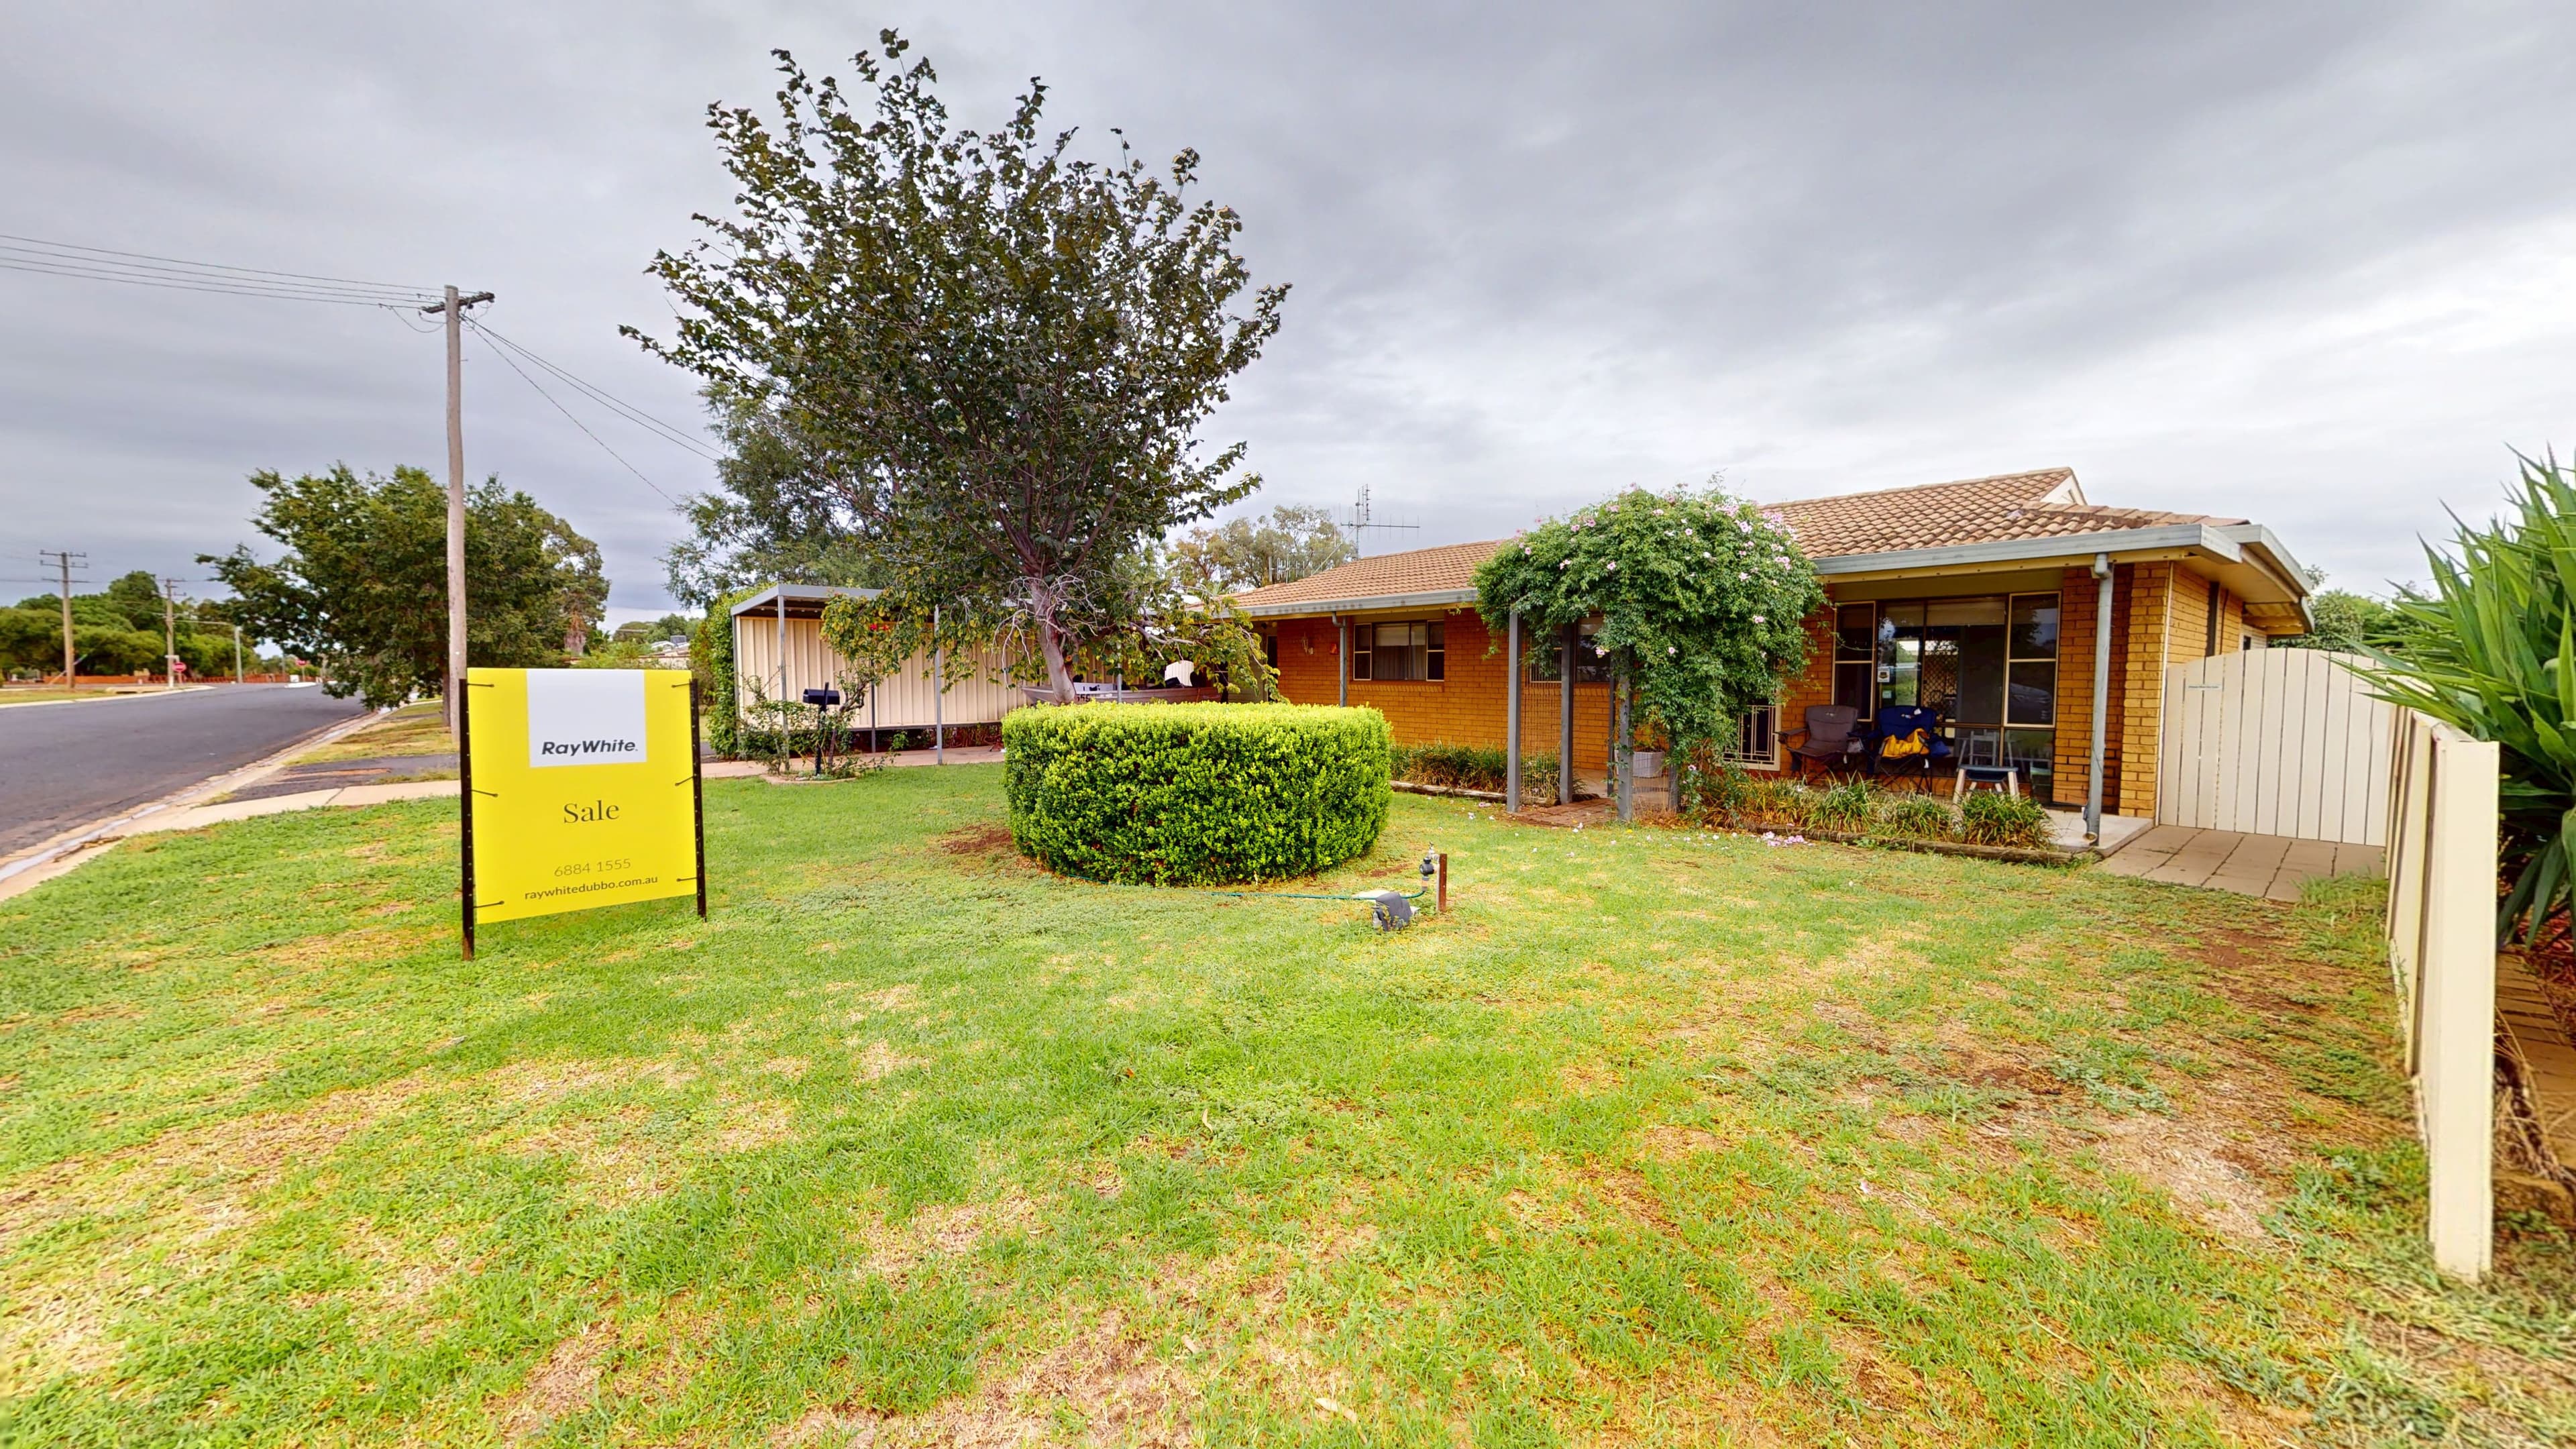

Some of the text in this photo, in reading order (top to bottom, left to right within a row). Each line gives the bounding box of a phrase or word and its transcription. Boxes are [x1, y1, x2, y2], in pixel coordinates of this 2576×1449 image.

[564, 800, 620, 824] Sale
[554, 858, 631, 877] 6884 1555
[525, 877, 658, 900] raywhitedubbo.com.au
